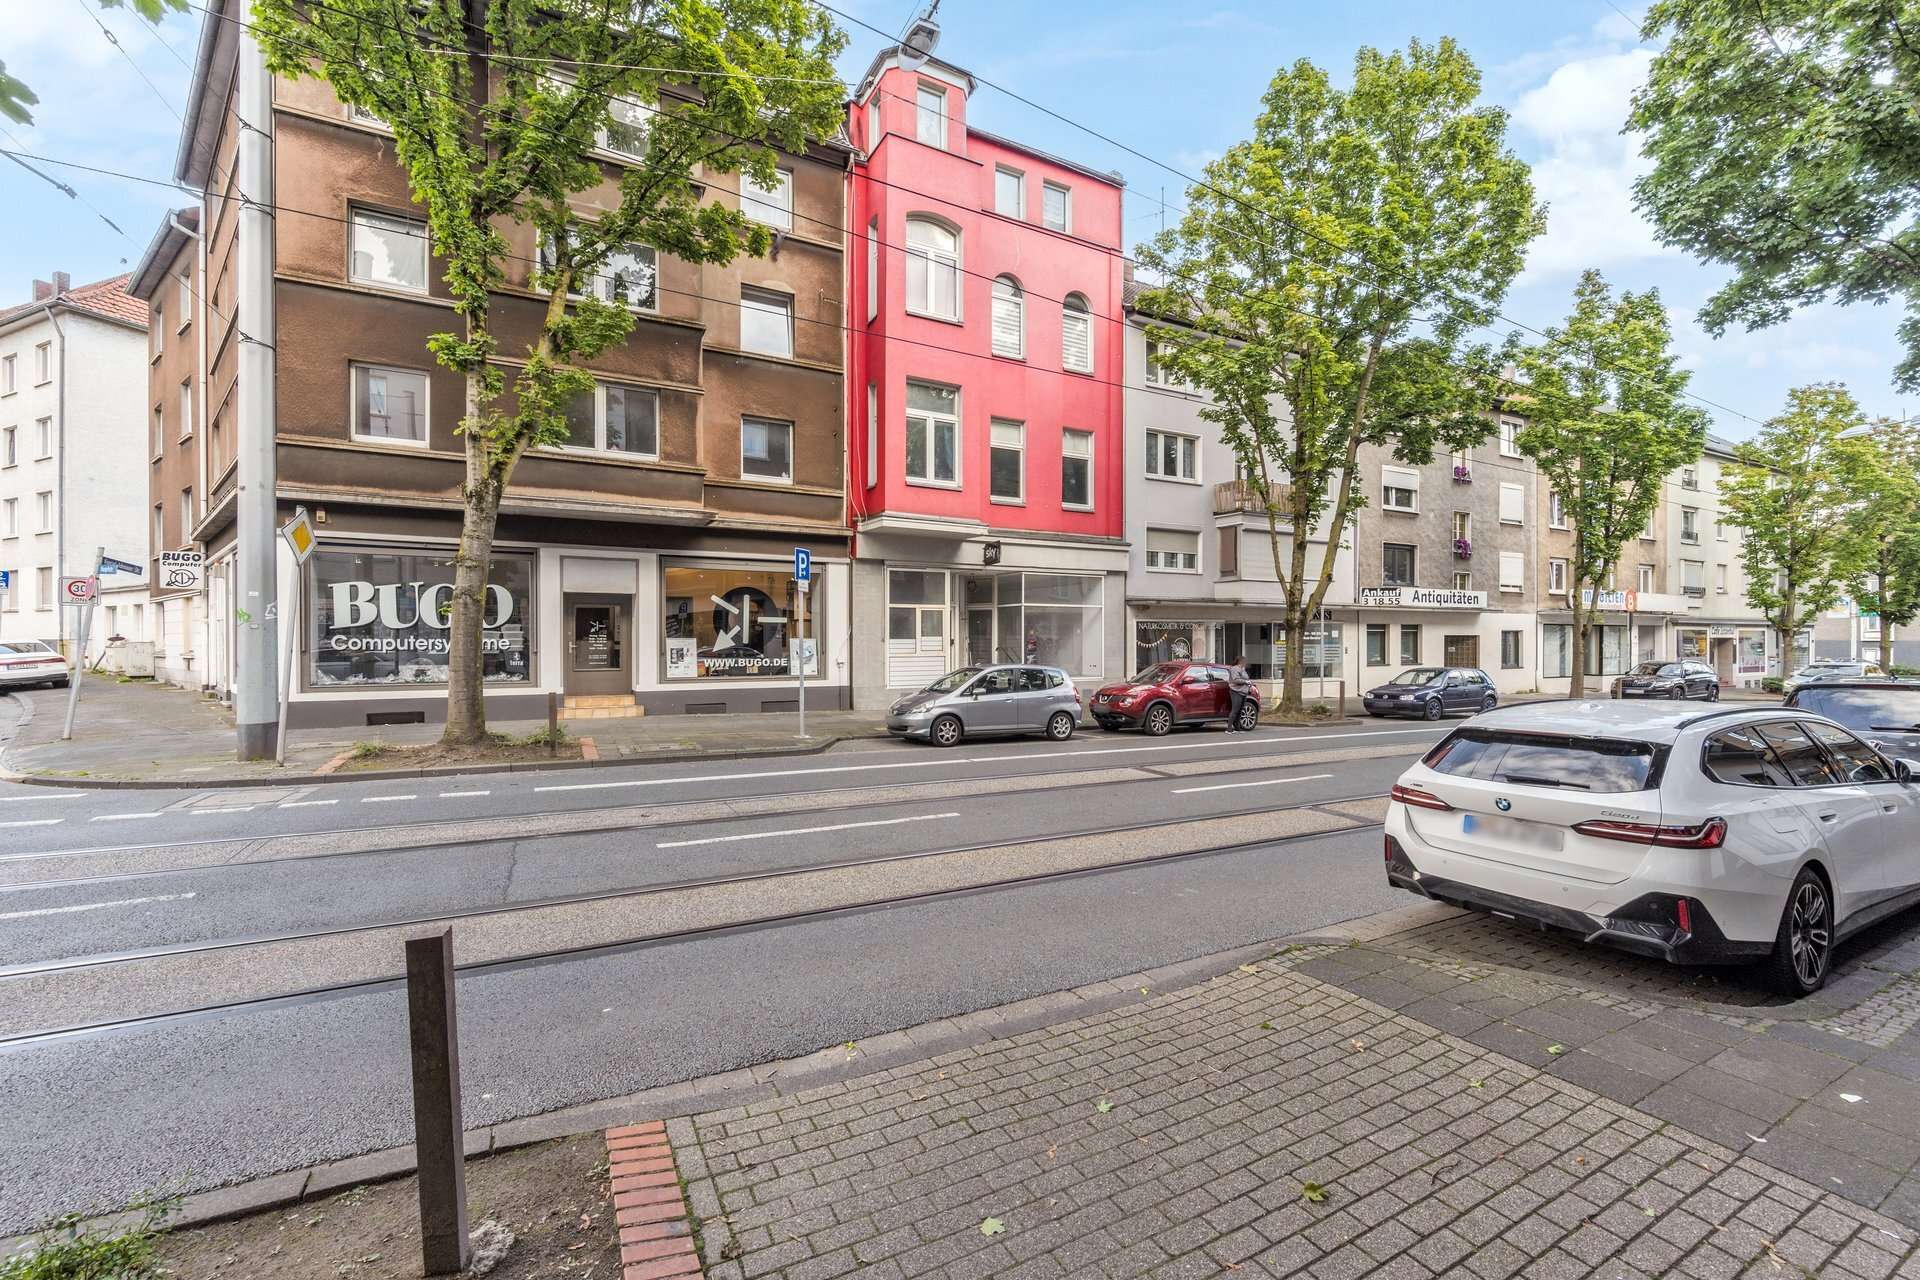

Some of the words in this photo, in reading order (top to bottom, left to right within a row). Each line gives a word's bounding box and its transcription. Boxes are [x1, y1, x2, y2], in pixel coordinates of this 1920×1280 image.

[162, 552, 202, 562] BUGO
[72, 584, 87, 593] 30
[1362, 588, 1400, 598] Ankauf
[1412, 590, 1479, 606] Antiquitäten
[330, 634, 511, 654] Computersyme
[704, 658, 788, 667] WWW.BUGO.DE
